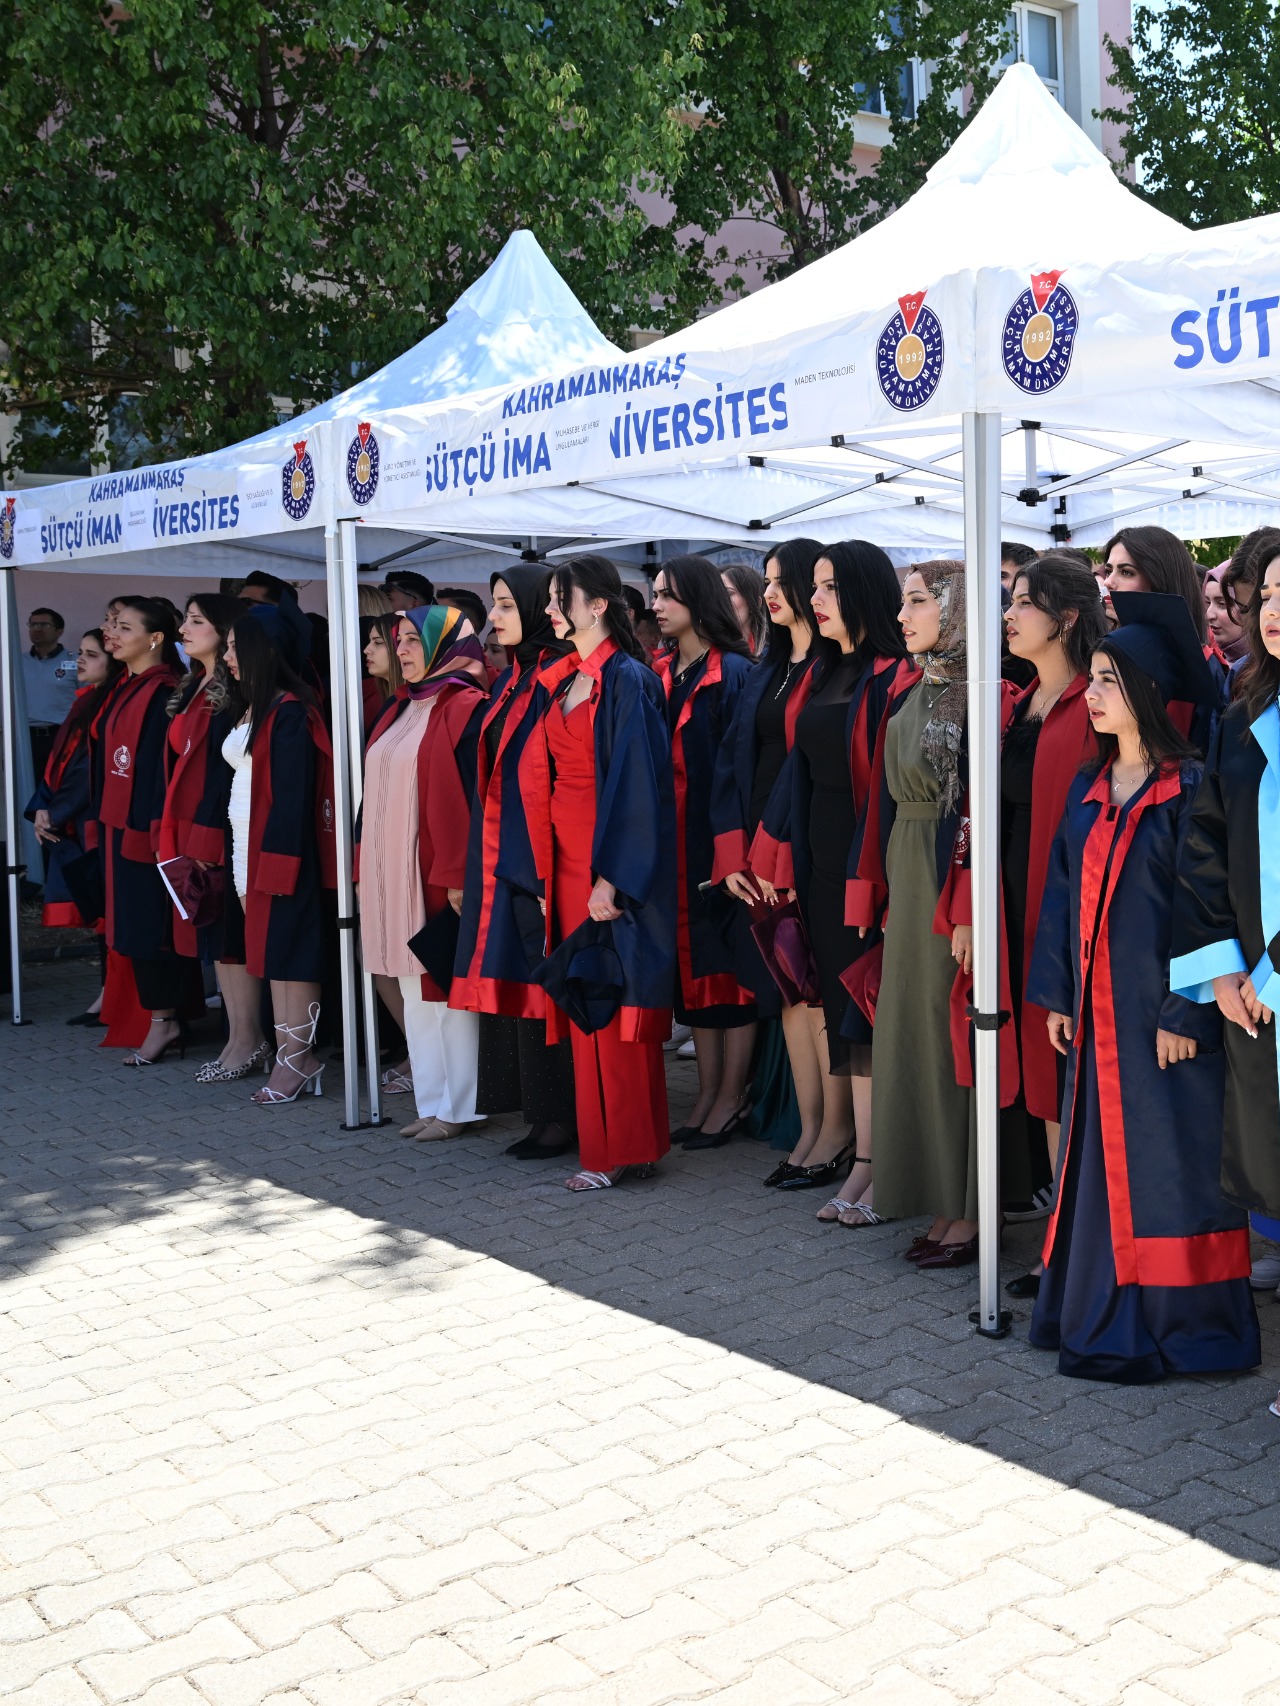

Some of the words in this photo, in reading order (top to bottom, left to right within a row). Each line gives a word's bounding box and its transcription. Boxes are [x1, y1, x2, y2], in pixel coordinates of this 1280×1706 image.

[898, 351, 923, 365] 1992
[1025, 330, 1051, 345] 1992
[502, 352, 687, 419] KAHRAMANMARAŞ
[794, 370, 817, 386] MADEN
[818, 362, 856, 380] TEKNOLOJİSİ
[610, 382, 789, 459] NİVERSİTES
[503, 428, 552, 480] İMA
[88, 467, 187, 503] KAHRAMANMARAŞ
[41, 511, 83, 557] SÜTÇÜ
[153, 490, 239, 537] İVERSİTES
